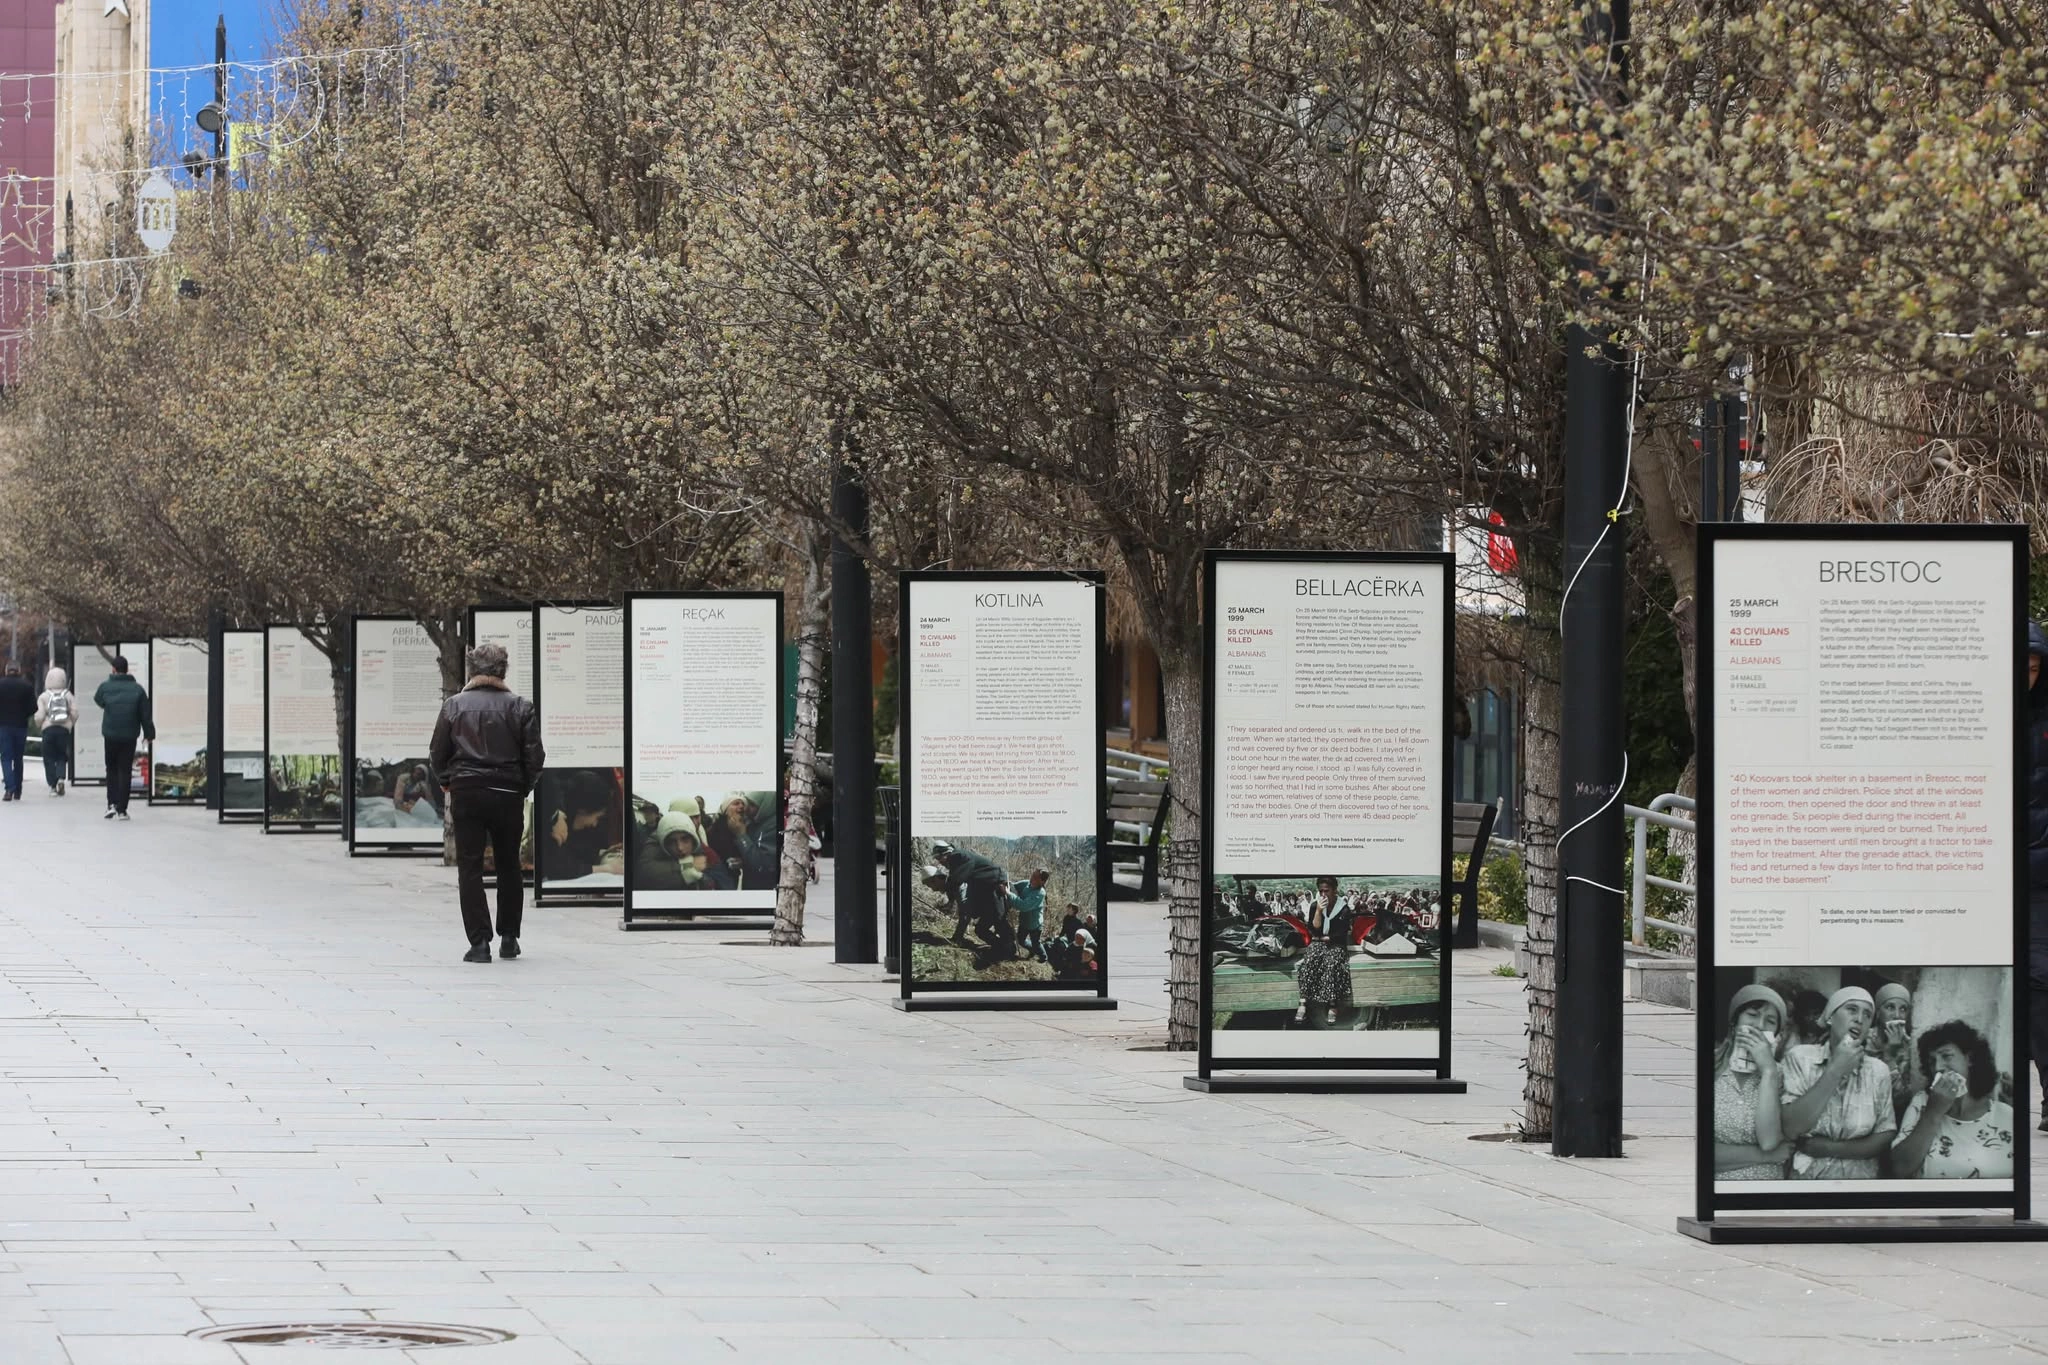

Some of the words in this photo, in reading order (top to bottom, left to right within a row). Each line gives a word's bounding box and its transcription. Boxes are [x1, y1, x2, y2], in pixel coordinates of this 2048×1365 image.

[1820, 561, 1941, 582] BRESTOC
[1296, 576, 1424, 596] BELLACËRKA
[975, 593, 1043, 607] KOTLINA
[682, 608, 724, 621] REÇAK
[1730, 786, 1739, 795] of
[1863, 786, 1891, 795] Police
[1944, 786, 1984, 795] windows
[1730, 799, 1739, 808] of
[1810, 800, 1846, 809] opened
[1890, 799, 1908, 807] and
[1792, 812, 1806, 820] Six
[1808, 812, 1840, 822] people
[1864, 812, 1894, 822] during
[1954, 812, 1966, 820] All
[1854, 825, 1885, 834] injured
[1936, 824, 1954, 832] The
[1955, 824, 1987, 834] injured
